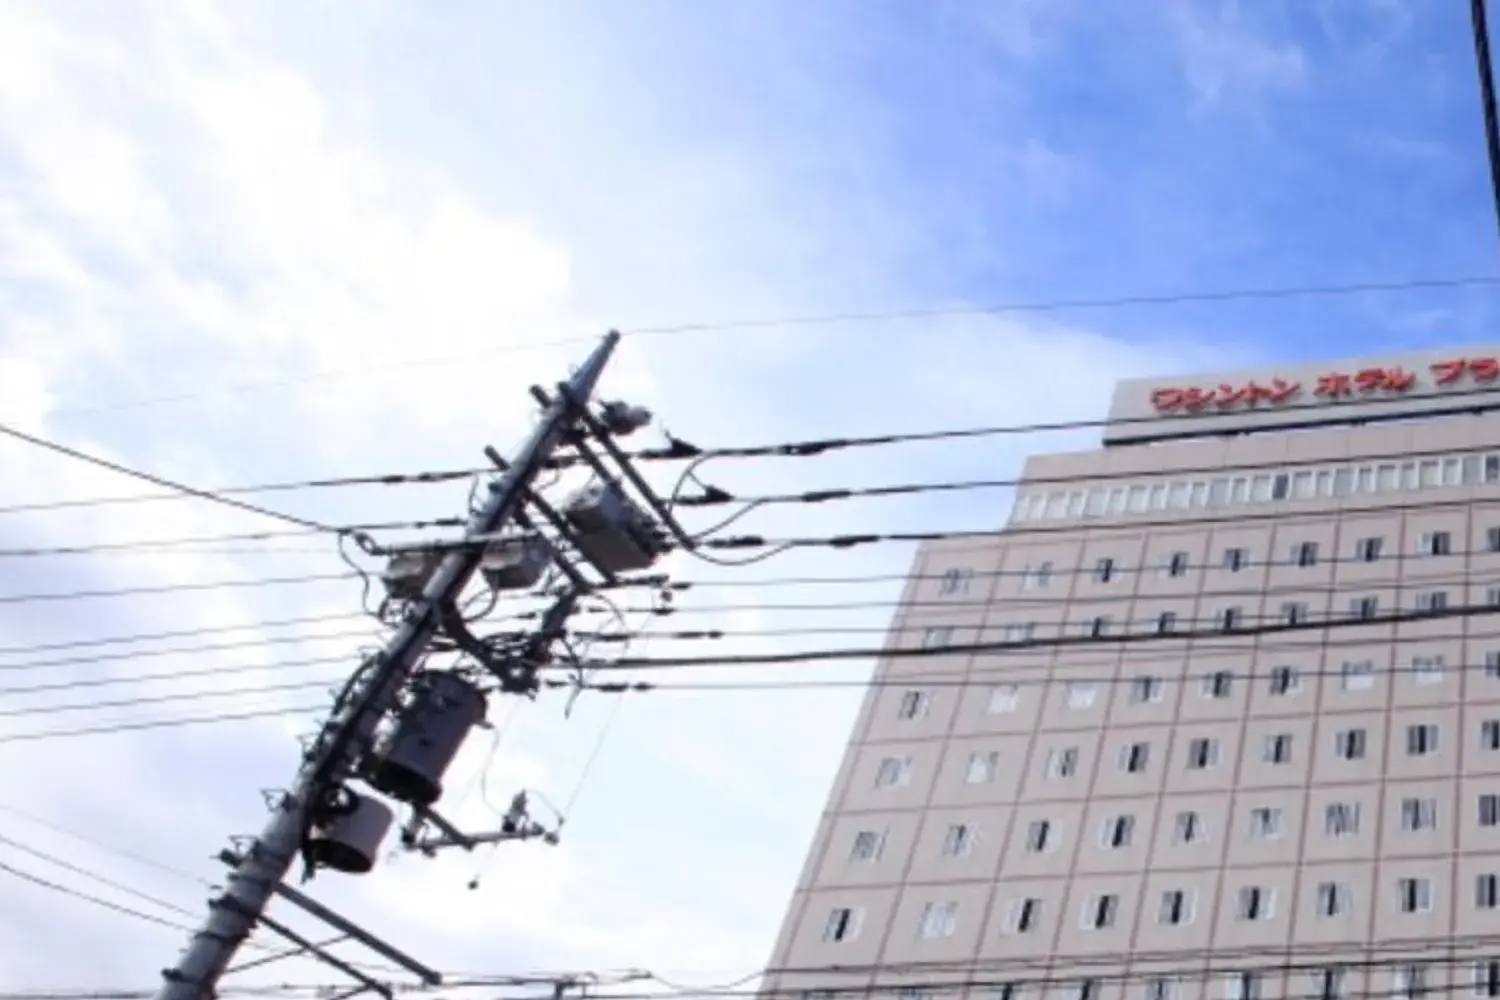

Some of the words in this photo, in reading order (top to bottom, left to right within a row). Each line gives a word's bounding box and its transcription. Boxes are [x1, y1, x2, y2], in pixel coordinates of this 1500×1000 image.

[1151, 372, 1302, 415] ワシントン
[1313, 365, 1417, 401] ホテル
